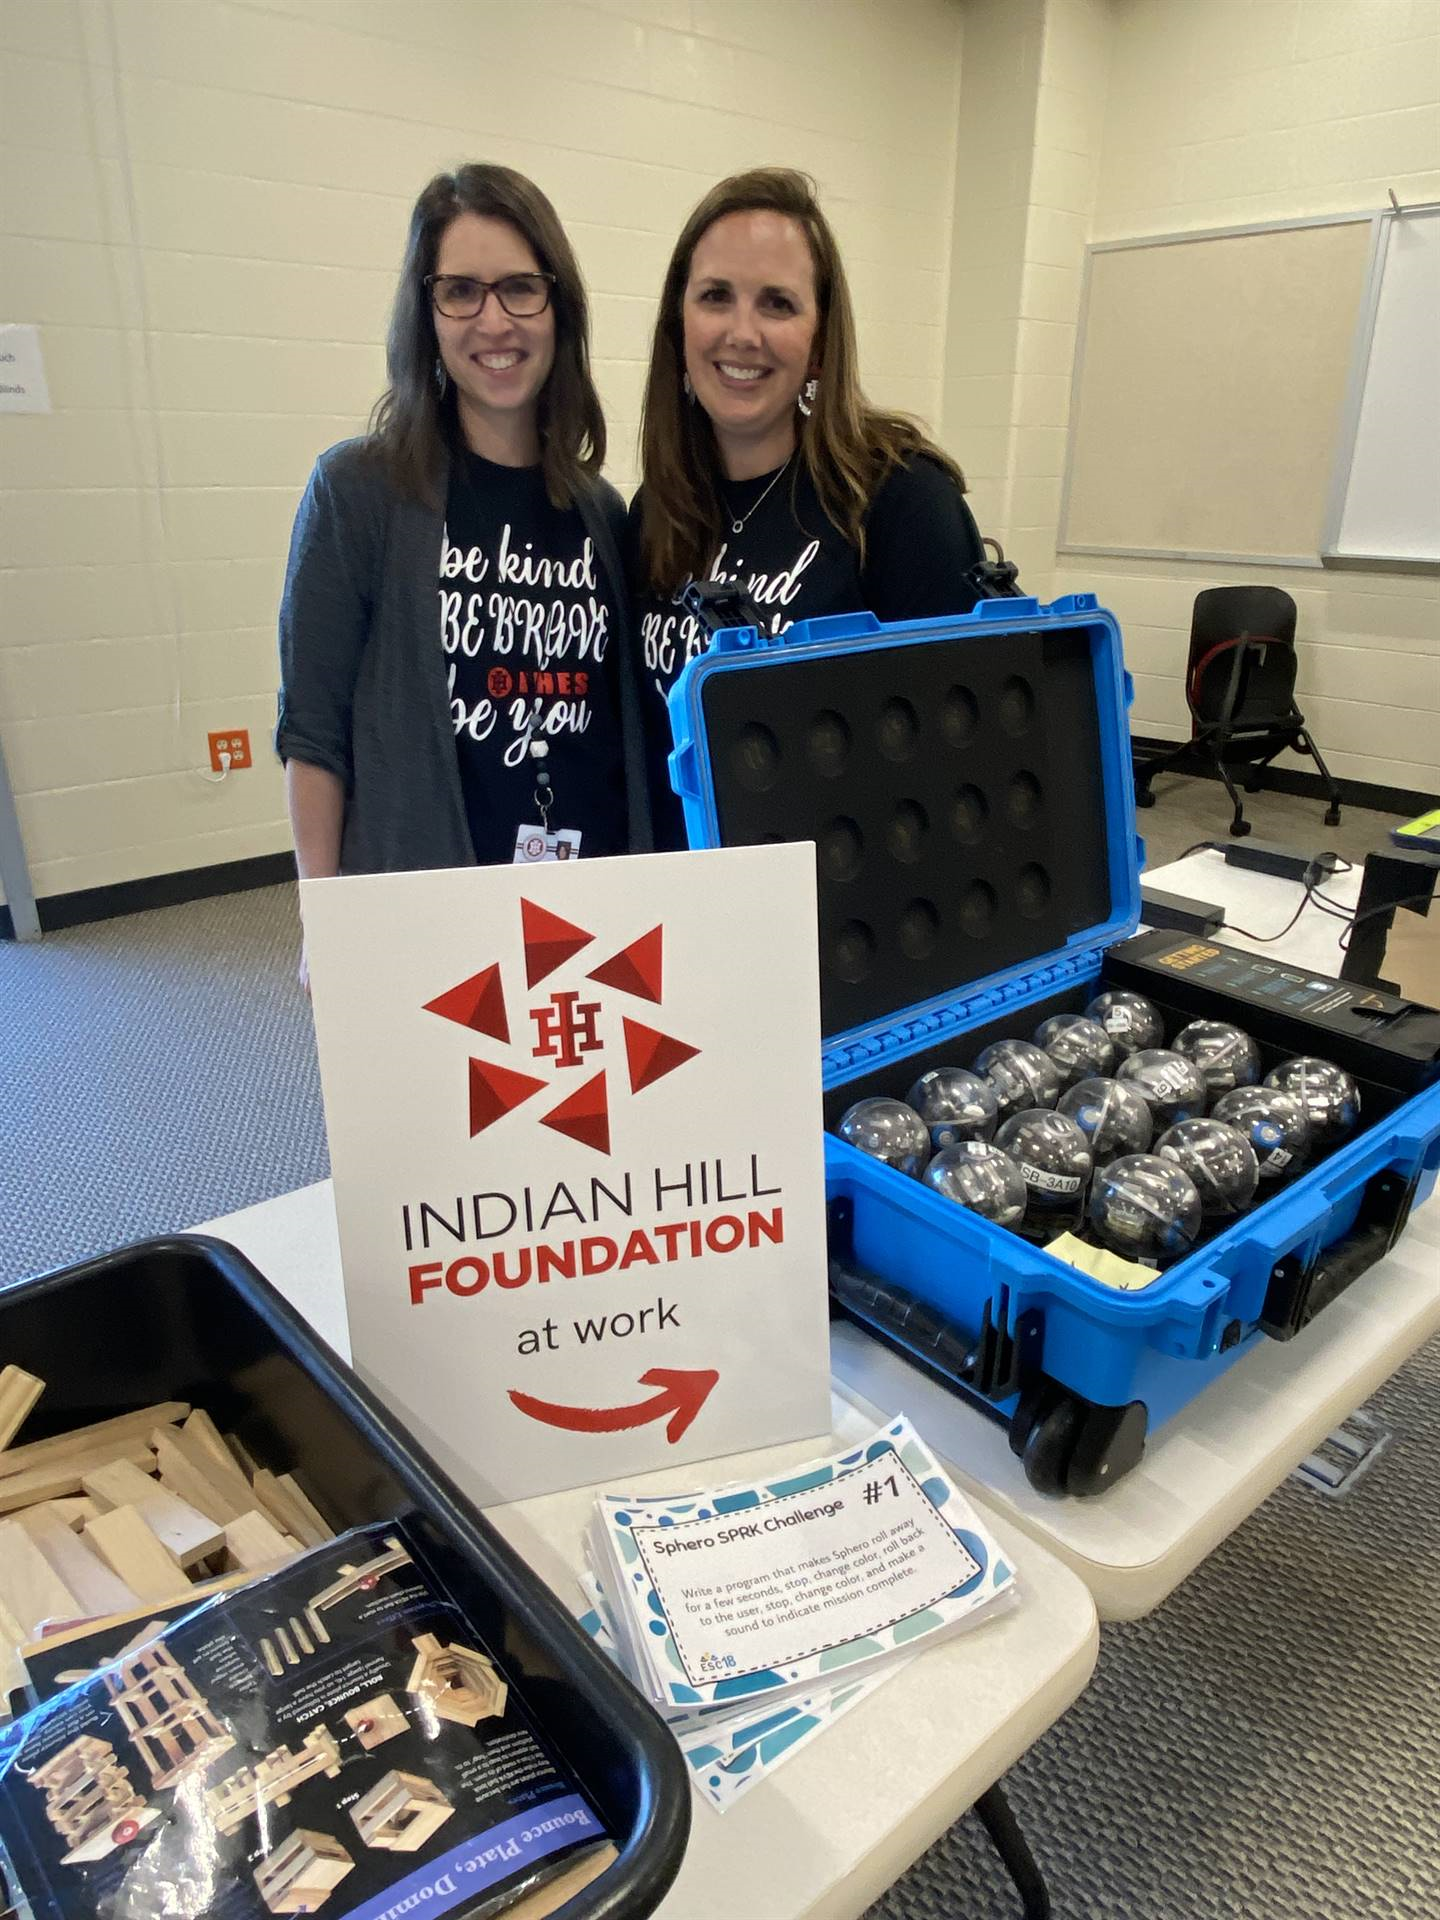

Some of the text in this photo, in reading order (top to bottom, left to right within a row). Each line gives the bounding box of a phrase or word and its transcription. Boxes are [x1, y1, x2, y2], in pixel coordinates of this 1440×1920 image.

[439, 521, 489, 583] be
[498, 524, 598, 591] kind
[438, 589, 485, 657] BE
[488, 592, 609, 672] BRAVE
[503, 697, 593, 768] you
[402, 1153, 782, 1251] INDIAN HILL
[1022, 1166, 1078, 1191] SB-3A10
[408, 1207, 784, 1305] FOUNDATION
[516, 1297, 680, 1355] at work
[862, 1475, 900, 1505] #1
[653, 1499, 845, 1557] Sphero SPRK Challenge
[681, 1586, 713, 1599] Write
[725, 1574, 770, 1593] program
[772, 1566, 796, 1579] that
[798, 1555, 831, 1571] makes
[832, 1541, 870, 1560] Sphero
[871, 1530, 888, 1544] roll
[890, 1517, 916, 1536] away
[685, 1602, 701, 1613] for
[713, 1598, 734, 1609] few
[736, 1586, 783, 1603] seconds,
[785, 1576, 812, 1591] stop,
[813, 1563, 851, 1581] change
[853, 1551, 882, 1568] color,
[883, 1540, 900, 1555] roll
[900, 1528, 925, 1545] back
[699, 1544, 925, 1626] to the user, stop, change color, and make a
[724, 1567, 917, 1637] sound to indicate mission complete.
[296, 1704, 326, 1723] CATCH
[373, 1809, 592, 1920] Bounce Plate, Domi
